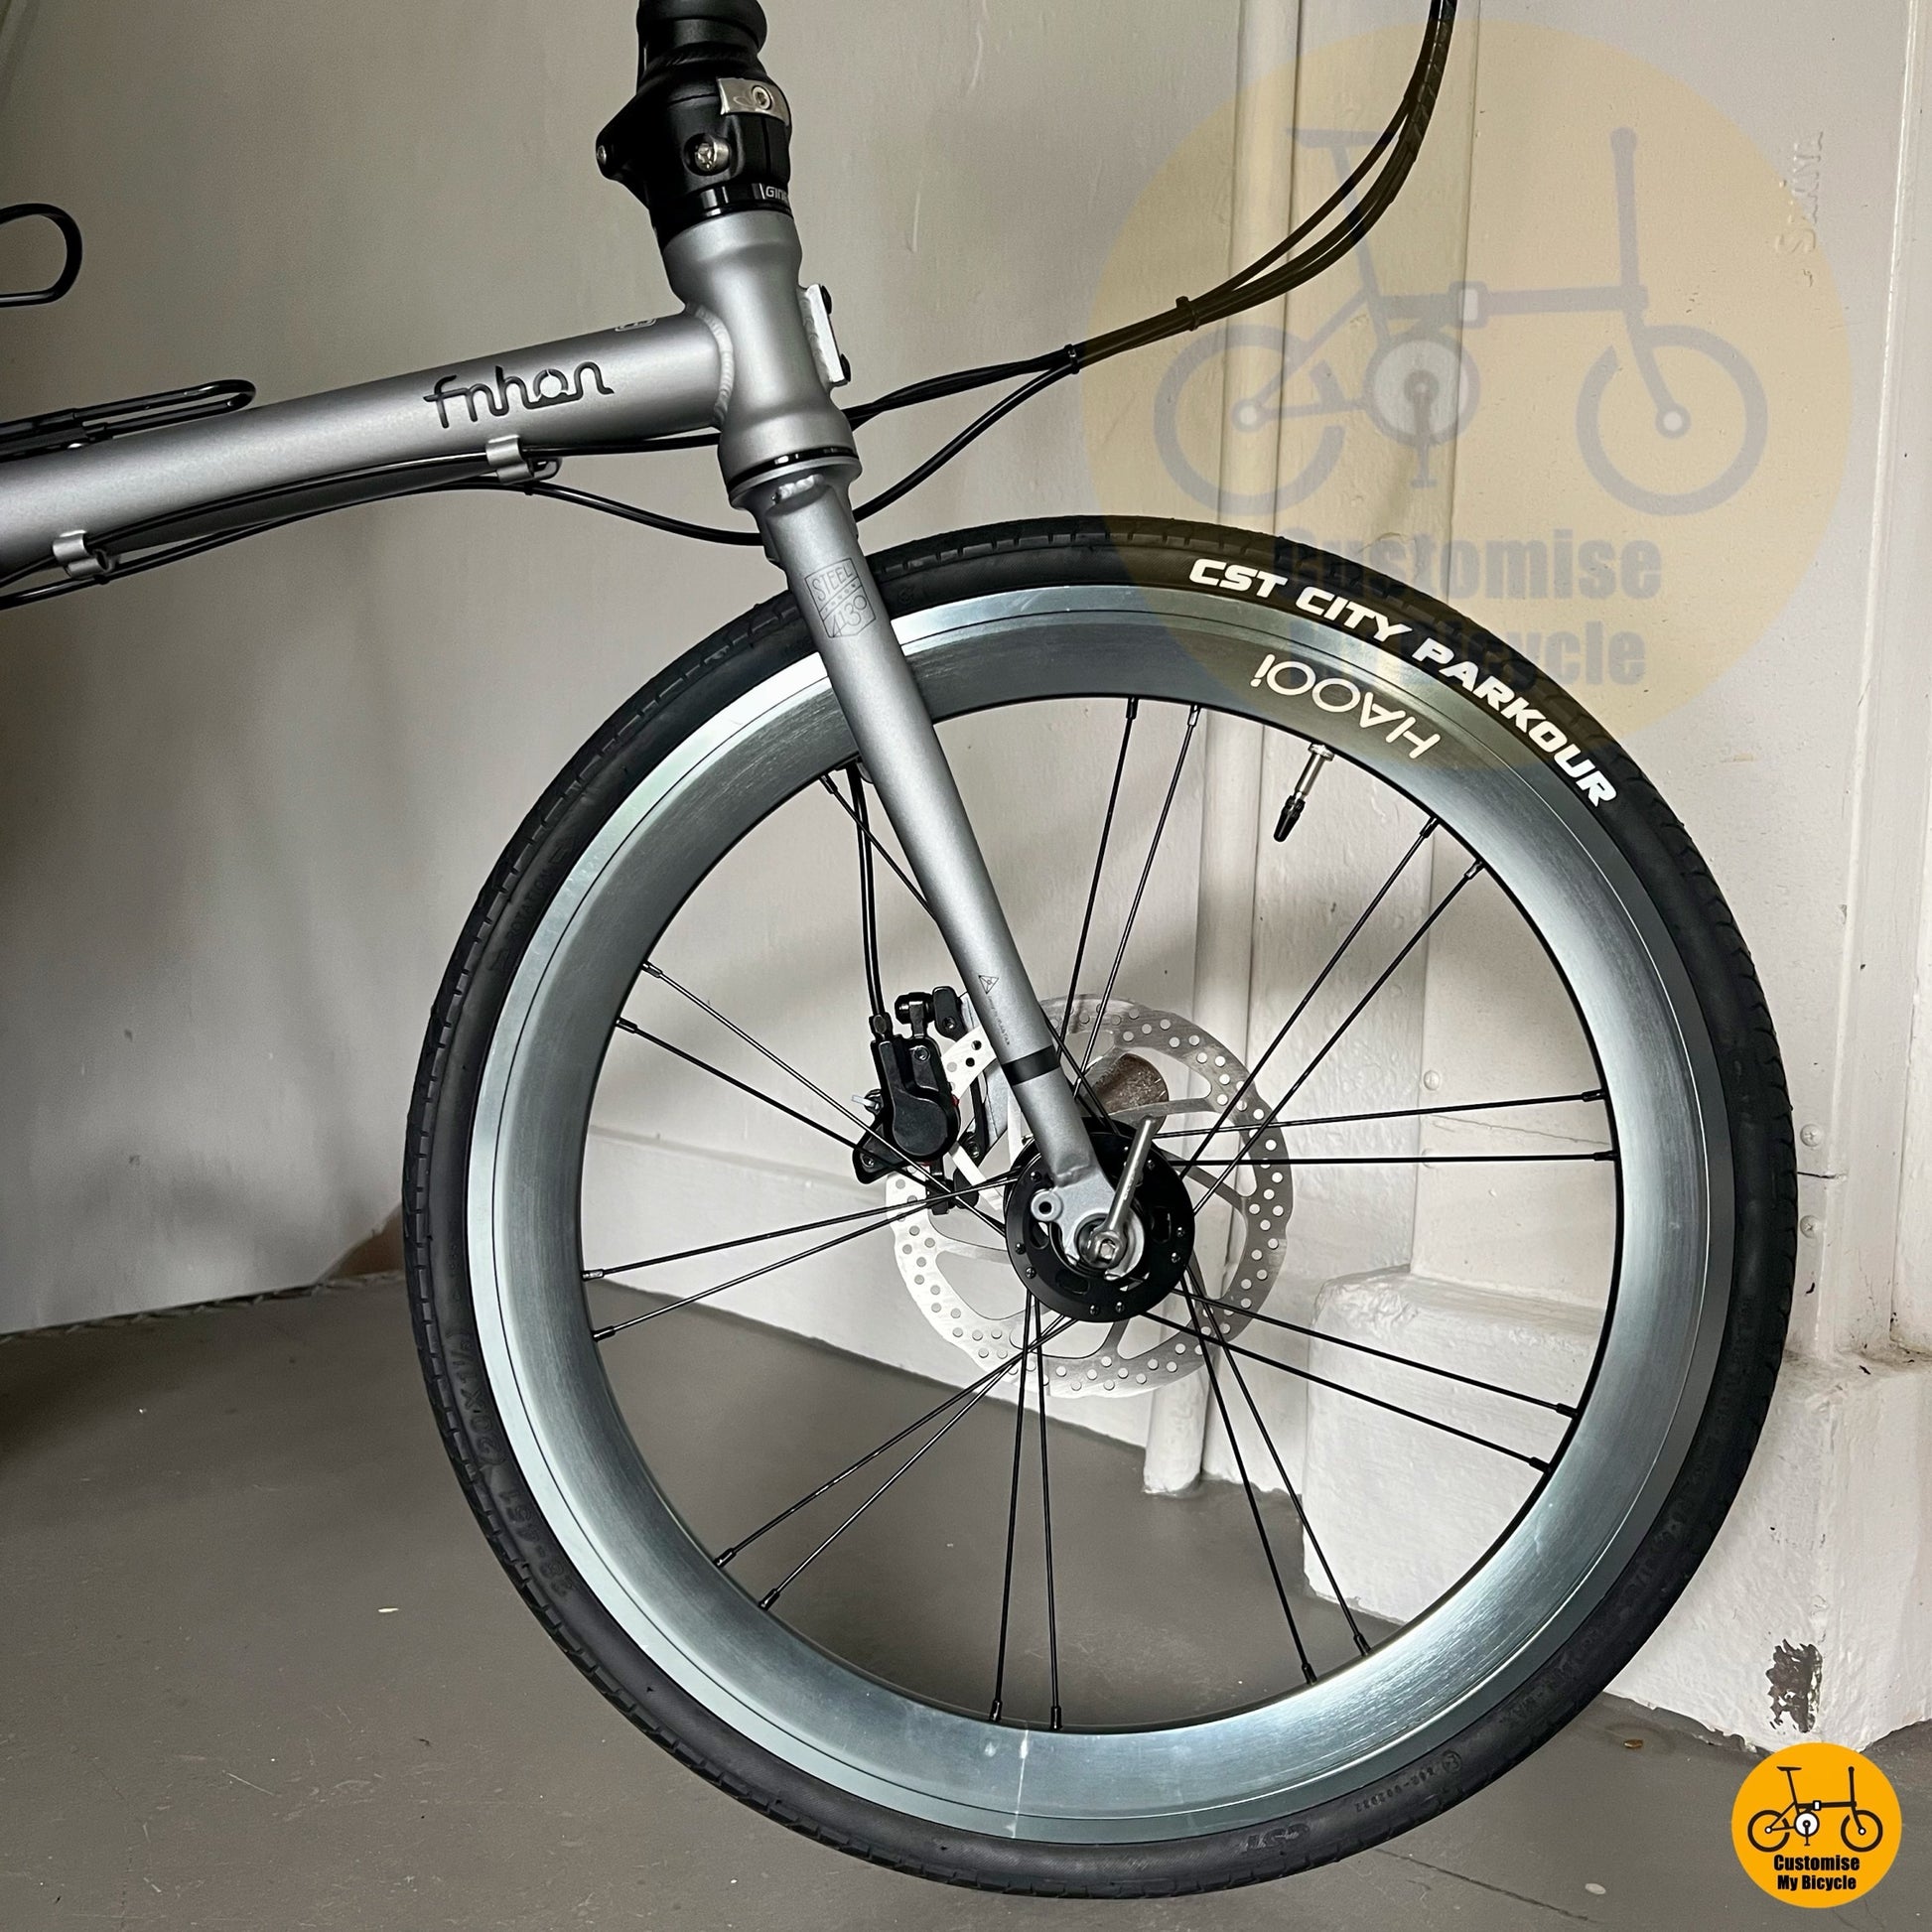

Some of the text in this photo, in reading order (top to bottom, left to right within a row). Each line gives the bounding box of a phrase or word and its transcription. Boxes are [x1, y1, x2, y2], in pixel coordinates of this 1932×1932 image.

[811, 564, 853, 602] STEEL
[1189, 558, 1617, 807] CST CITY PARKOUR
